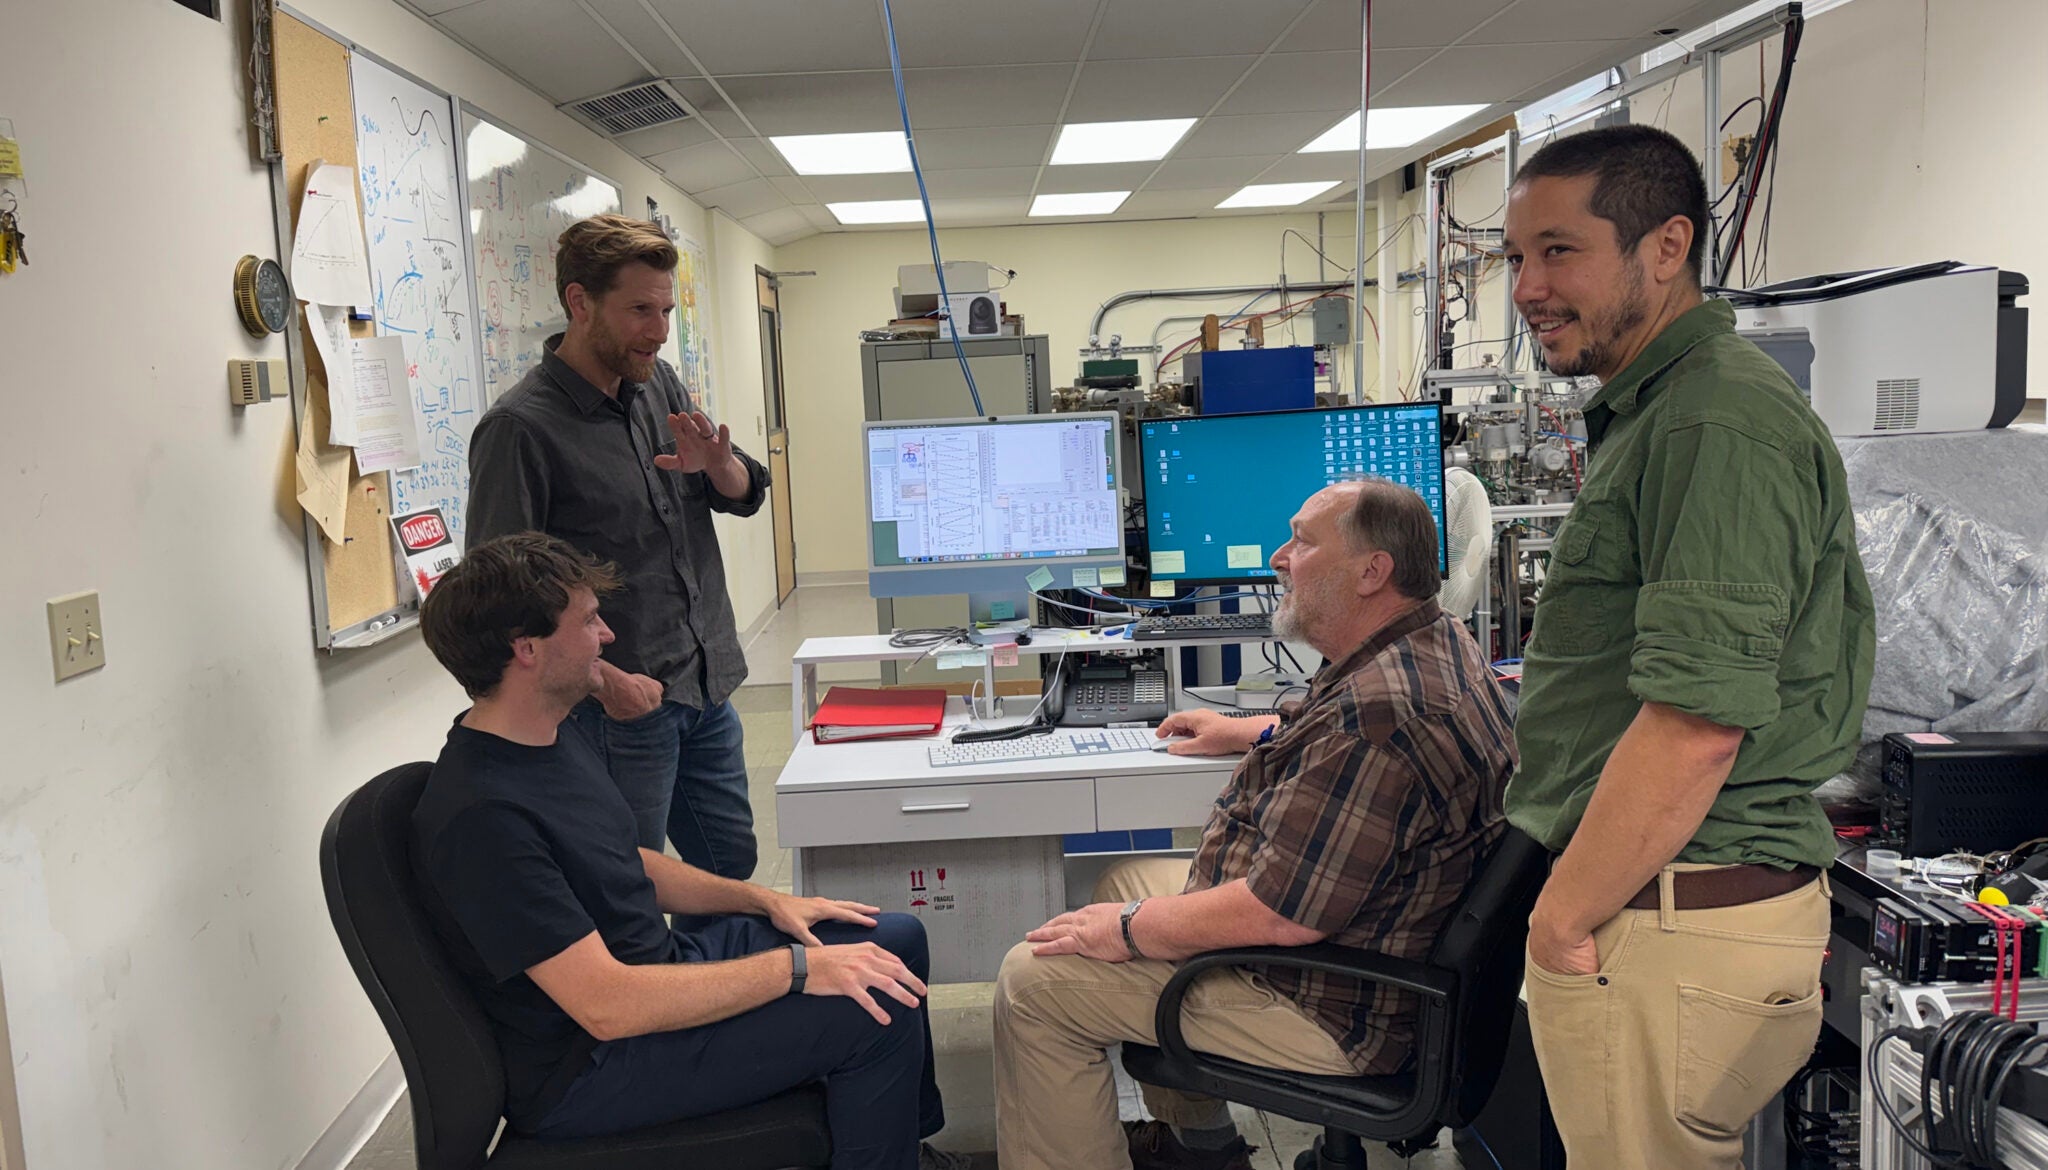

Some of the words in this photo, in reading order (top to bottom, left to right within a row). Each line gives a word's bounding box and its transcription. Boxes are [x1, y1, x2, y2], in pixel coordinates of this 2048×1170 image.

[403, 517, 444, 546] DANGER
[433, 557, 455, 573] LASER
[933, 894, 955, 903] FRAGILE
